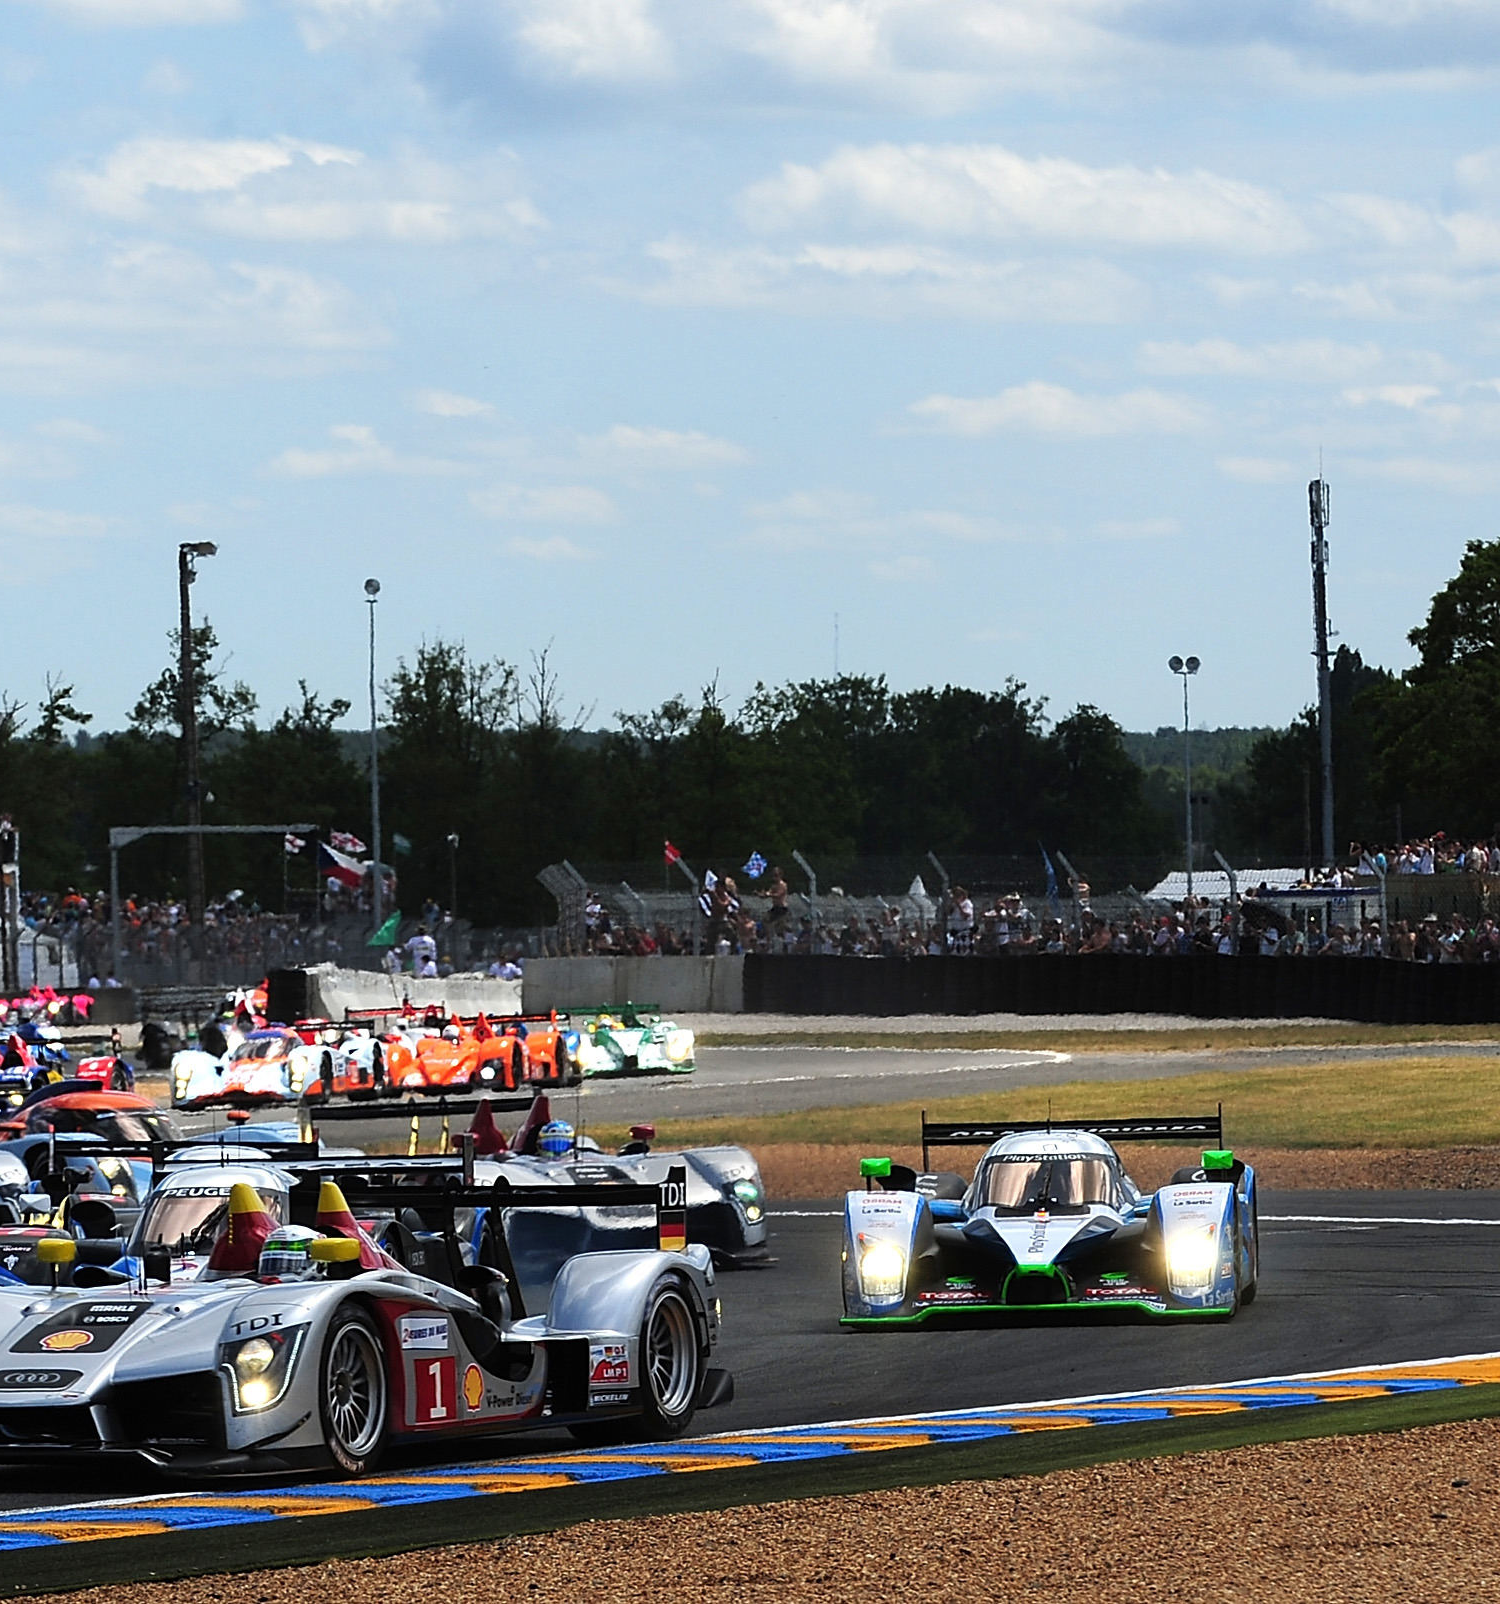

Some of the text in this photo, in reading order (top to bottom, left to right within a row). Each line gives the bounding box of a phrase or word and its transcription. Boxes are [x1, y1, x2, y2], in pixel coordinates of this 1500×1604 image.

[1003, 1153, 1087, 1162] PlayStation
[162, 1187, 231, 1198] PEUGE
[658, 1182, 685, 1207] TDI
[231, 1313, 283, 1335] TDI
[429, 1361, 447, 1419] 1
[487, 1395, 514, 1408] V-Power
